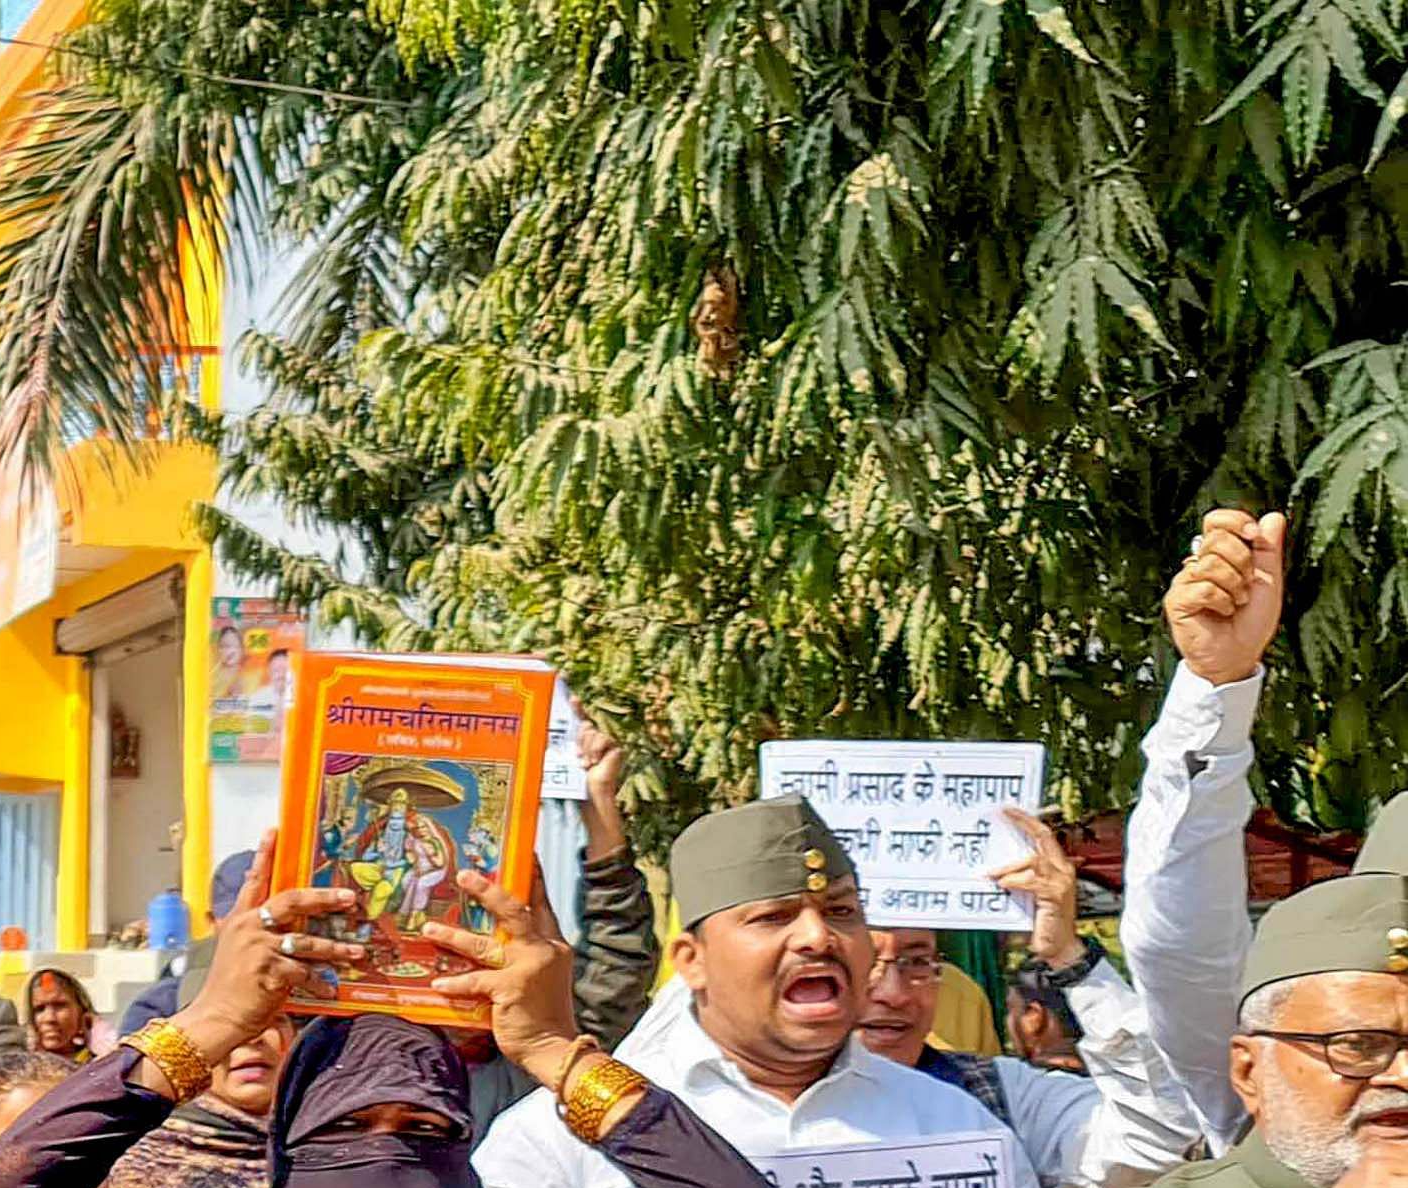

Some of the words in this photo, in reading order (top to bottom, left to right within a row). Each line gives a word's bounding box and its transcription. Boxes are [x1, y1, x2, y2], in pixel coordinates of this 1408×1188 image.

[913, 760, 935, 804] के
[943, 774, 1025, 813] महापाप
[881, 888, 948, 914] अवाम
